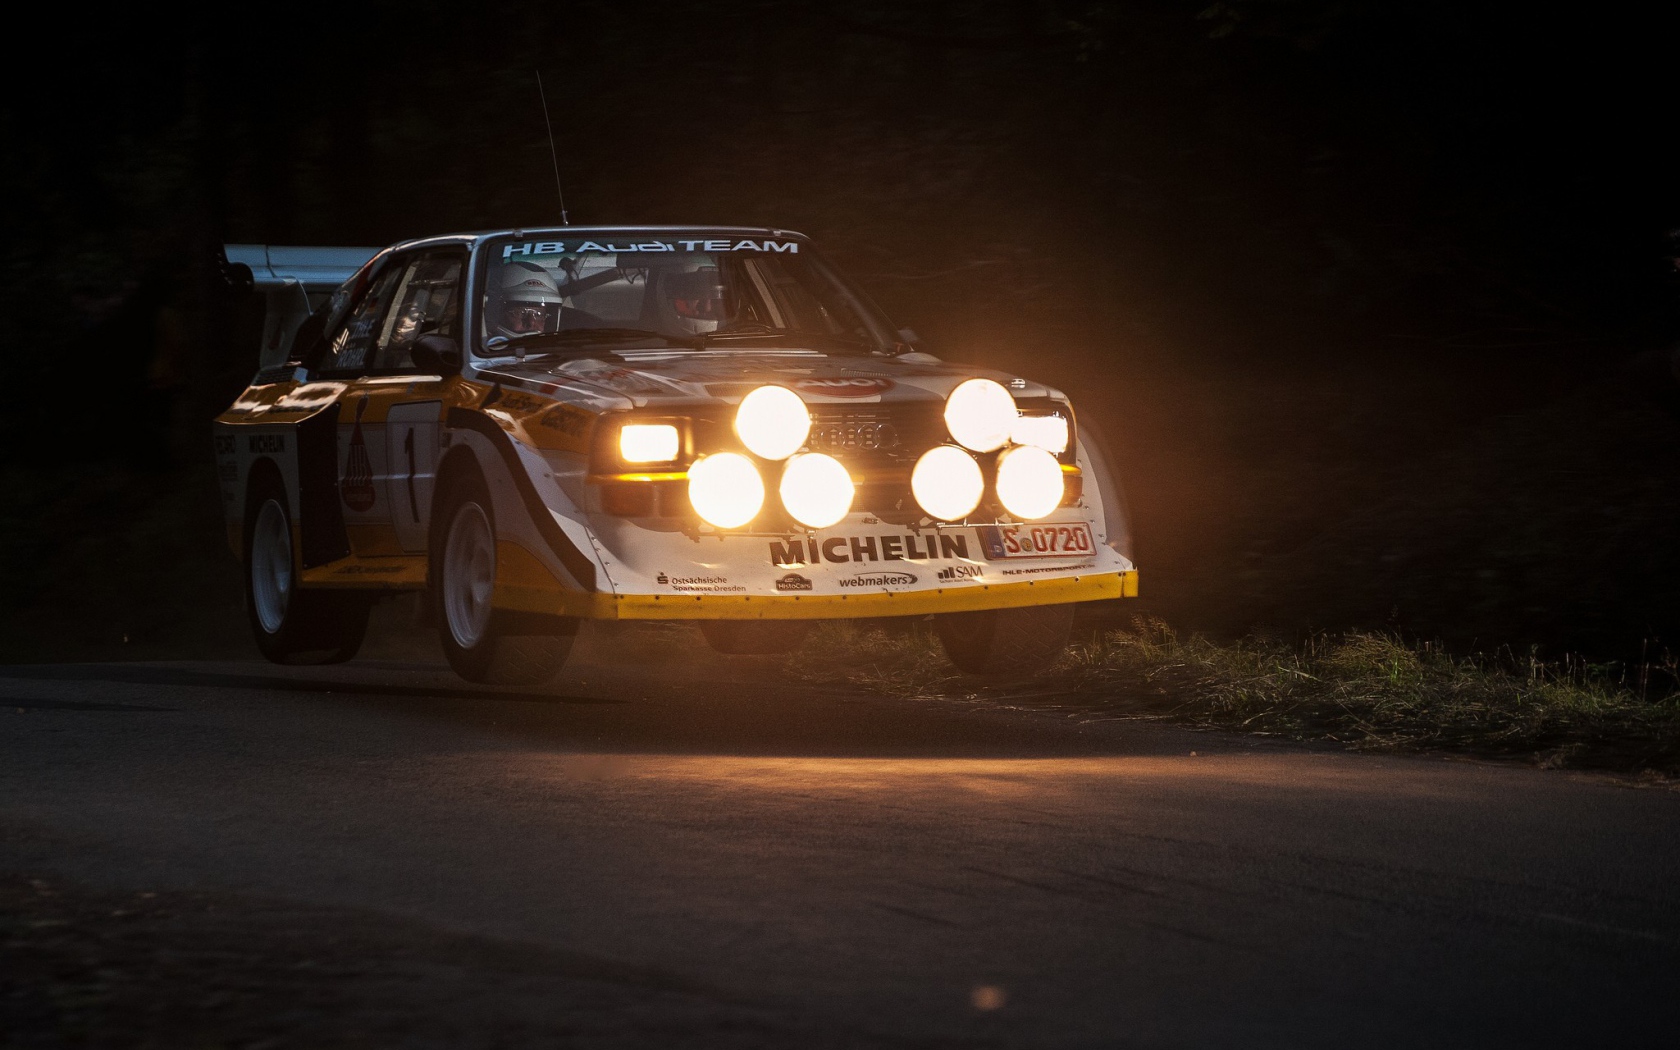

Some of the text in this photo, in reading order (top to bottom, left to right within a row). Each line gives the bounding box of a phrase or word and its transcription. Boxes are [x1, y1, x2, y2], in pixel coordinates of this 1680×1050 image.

[502, 241, 565, 257] HB
[678, 240, 798, 253] TEAM
[249, 434, 285, 453] MICHELIN
[405, 428, 420, 523] 1
[1003, 527, 1090, 553] S 0720
[769, 534, 970, 566] MICHELIN
[671, 576, 728, 585] Ostsächsische
[956, 566, 984, 578] SAM
[839, 575, 909, 588] webmakers
